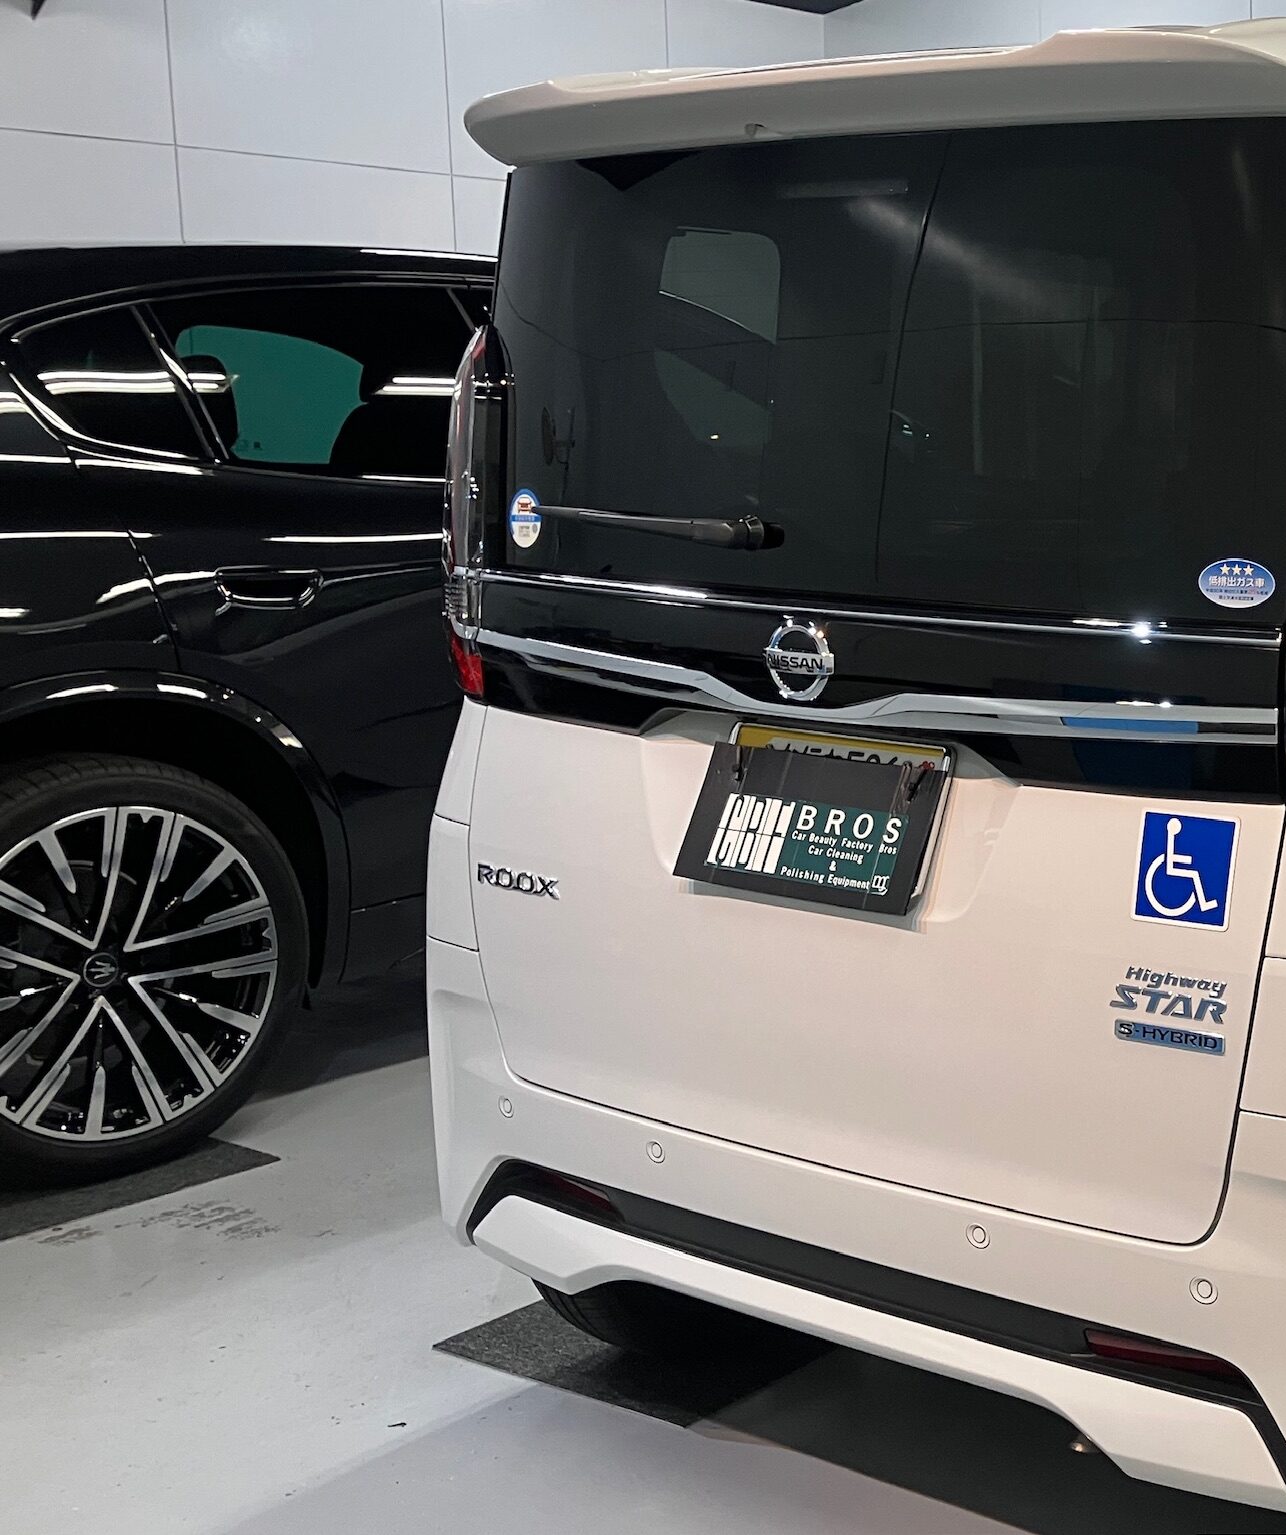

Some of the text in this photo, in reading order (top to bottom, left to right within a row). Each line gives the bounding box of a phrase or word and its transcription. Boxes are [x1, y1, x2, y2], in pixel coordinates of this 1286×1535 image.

[1208, 575, 1265, 588] 低排出ガス車
[767, 653, 823, 670] NISSAN
[796, 804, 902, 844] BROS
[791, 830, 898, 855] Car Beauty Factory Bros
[808, 845, 864, 865] Car Cleaning
[780, 865, 825, 884] Polishing
[827, 873, 871, 890] Equipment
[828, 860, 837, 872] &
[477, 863, 560, 901] ROOX
[1125, 966, 1228, 999] Highway
[1109, 983, 1228, 1025] STAR
[1118, 1023, 1218, 1049] S-HYBRID
